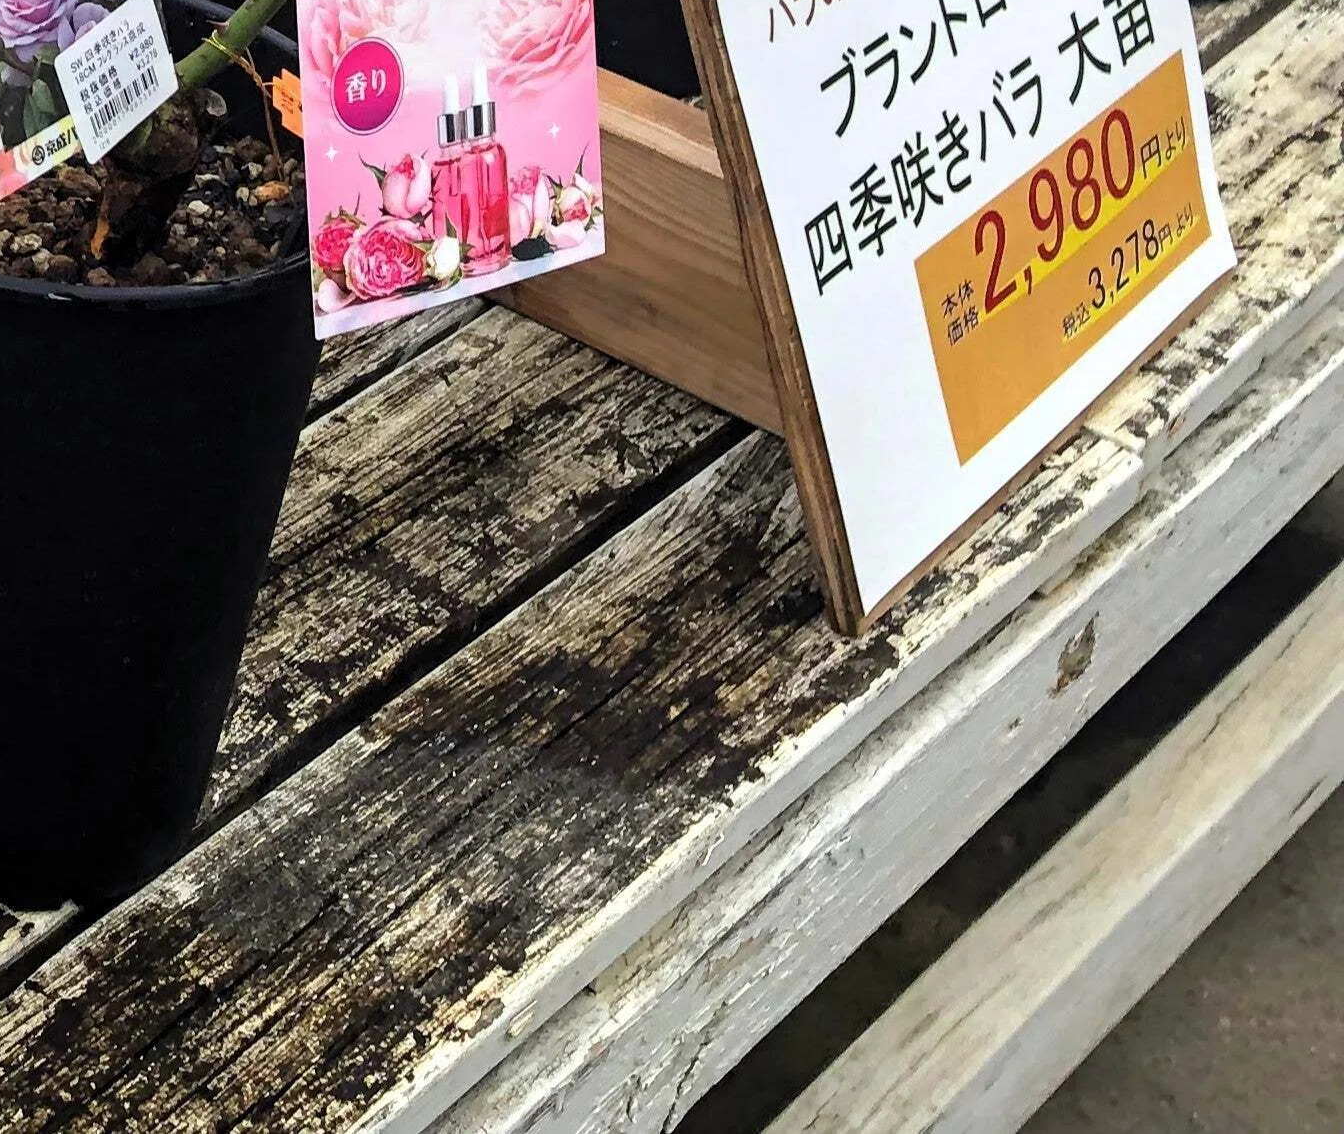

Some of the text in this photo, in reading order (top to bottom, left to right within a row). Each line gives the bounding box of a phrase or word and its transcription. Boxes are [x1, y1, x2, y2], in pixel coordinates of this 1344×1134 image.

[344, 66, 388, 105] 香り
[803, 57, 1044, 297] 四季咲きバラ
